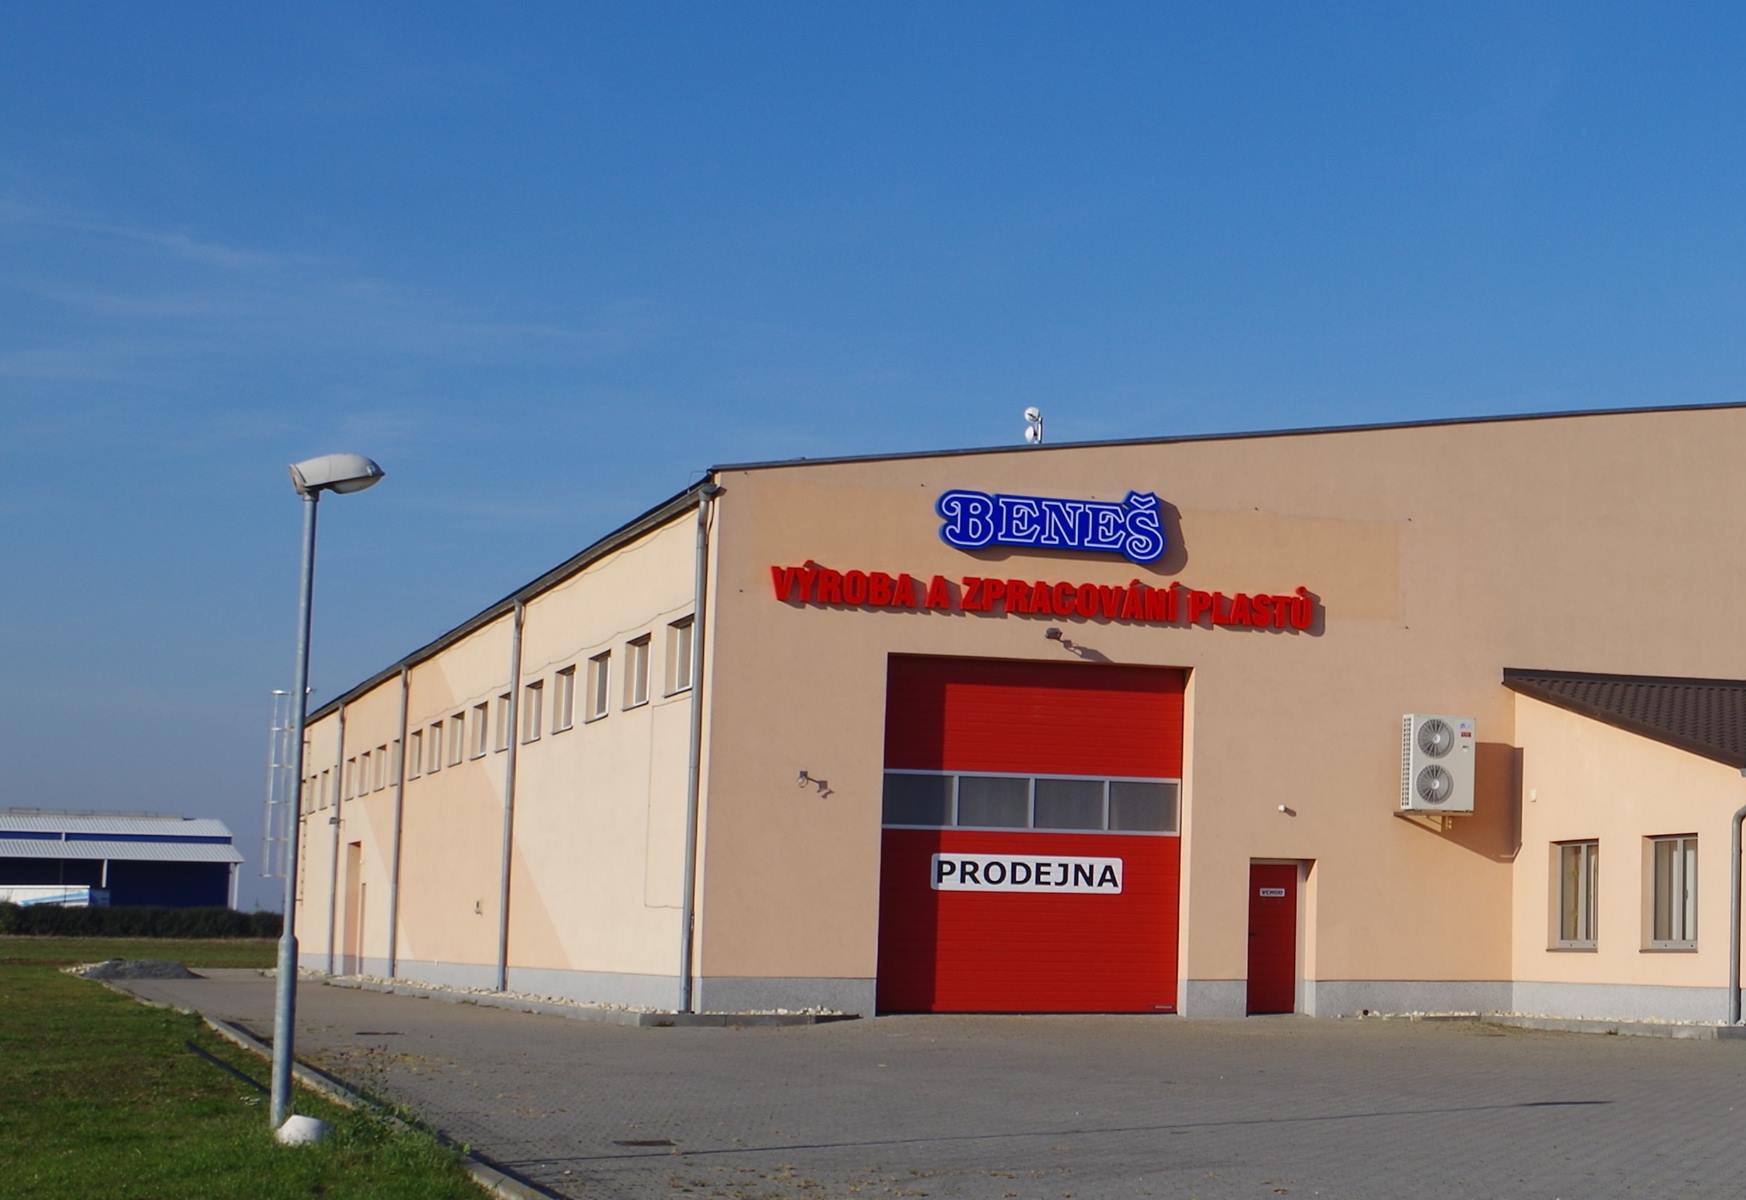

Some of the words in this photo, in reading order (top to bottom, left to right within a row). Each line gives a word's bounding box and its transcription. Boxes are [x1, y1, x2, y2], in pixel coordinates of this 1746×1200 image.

[941, 493, 1164, 560] BENEŠ
[771, 559, 915, 608] VÝROBA
[925, 575, 949, 609] A
[960, 576, 1181, 622] ZPRACOVÁNÍ
[1188, 585, 1312, 630] PLASTŮ
[936, 860, 1119, 888] PRODEJNA
